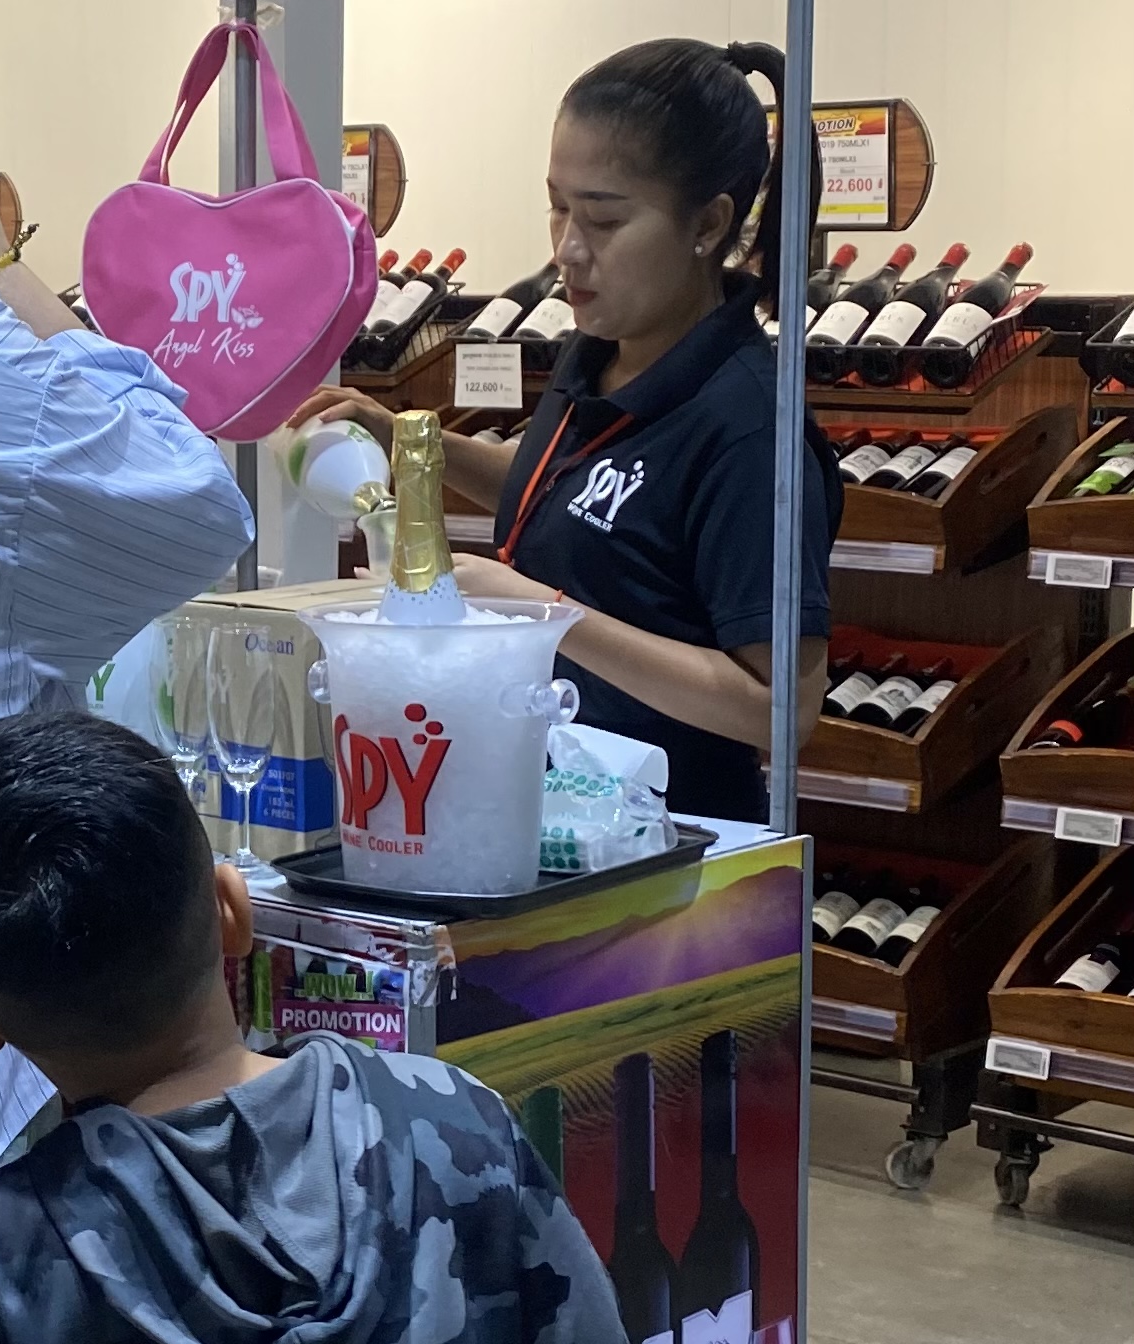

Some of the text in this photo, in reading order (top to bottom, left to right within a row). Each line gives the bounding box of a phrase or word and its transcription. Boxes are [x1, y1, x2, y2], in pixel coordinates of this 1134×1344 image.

[816, 117, 855, 132] OTION
[169, 258, 247, 323] SPY
[153, 327, 255, 368] Angel Kiss
[571, 458, 644, 522] SPY
[584, 511, 613, 532] COOLER
[245, 632, 295, 656] Ocean
[334, 712, 453, 836] SPY
[271, 808, 295, 820] PIECES
[368, 836, 424, 855] COOLER
[281, 1007, 402, 1034] PROMOTION
